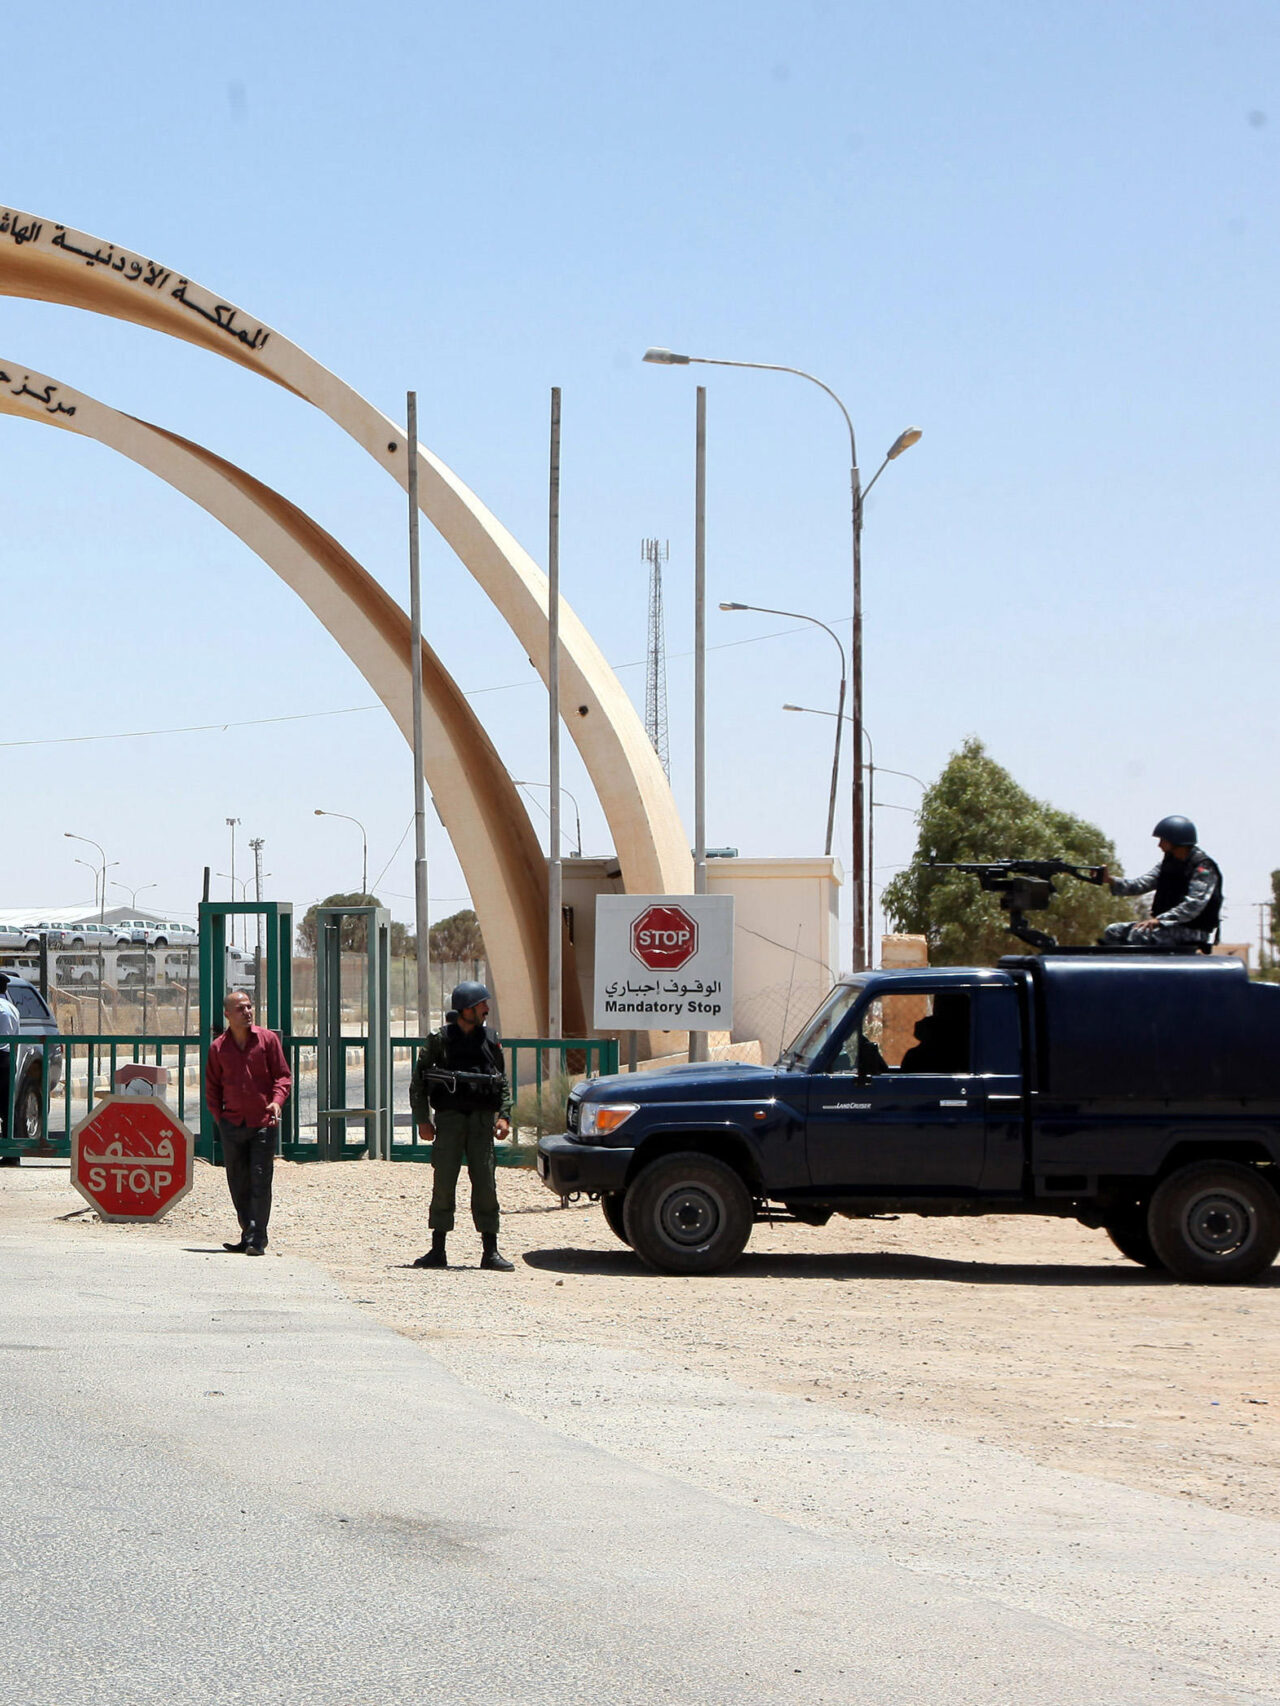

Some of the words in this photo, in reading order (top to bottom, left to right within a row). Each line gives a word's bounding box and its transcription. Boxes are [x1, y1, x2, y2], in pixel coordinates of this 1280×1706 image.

[11, 375, 77, 417] مركز
[639, 930, 691, 946] STOP
[605, 979, 660, 998] إجباري
[663, 979, 721, 997] الوقوف
[605, 1001, 683, 1015] Mandatory
[687, 1001, 721, 1016] Stop
[83, 1129, 175, 1166] قف
[87, 1167, 173, 1194] STOP
